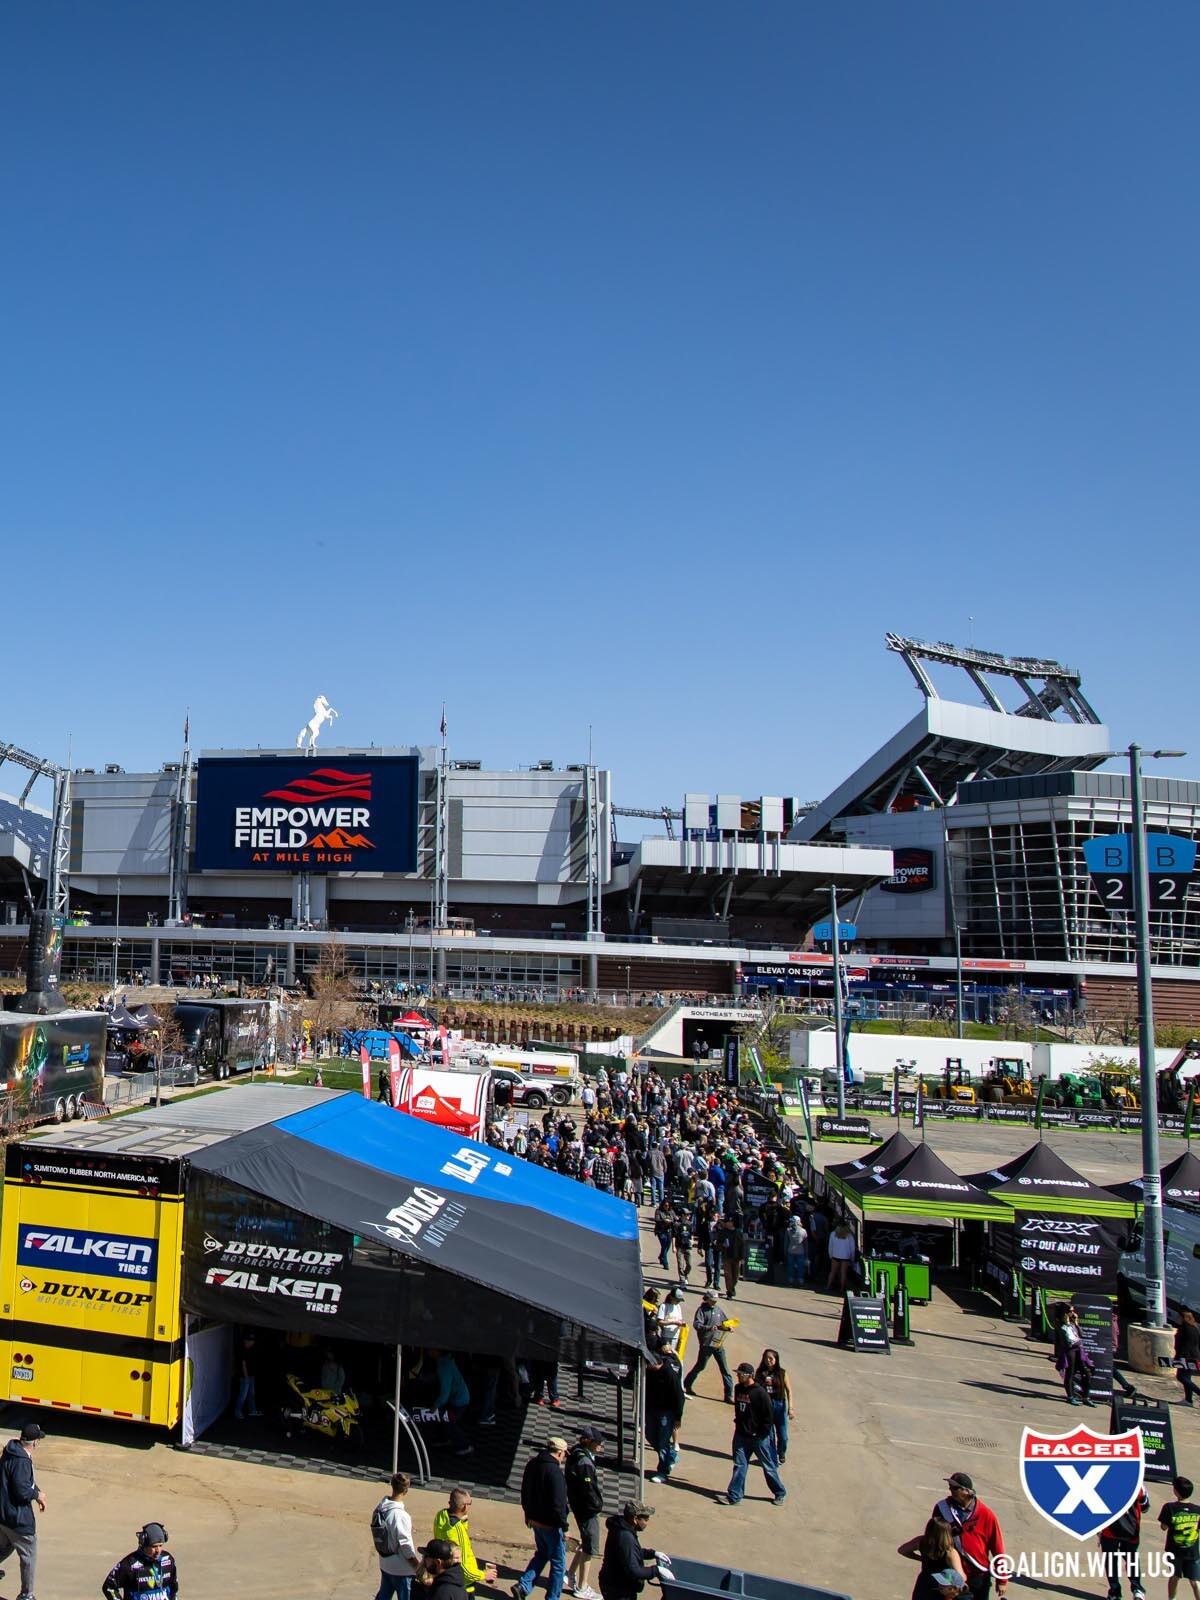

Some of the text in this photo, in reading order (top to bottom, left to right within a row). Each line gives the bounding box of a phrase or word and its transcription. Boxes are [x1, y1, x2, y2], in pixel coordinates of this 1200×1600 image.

[235, 807, 370, 828] EMPOWER
[235, 828, 308, 848] FIELD
[252, 853, 352, 862] AT MILE HIGH
[1105, 847, 1175, 868] B B
[895, 867, 929, 876] POWER
[1106, 879, 1176, 900] 2 2
[822, 928, 849, 938] B B
[823, 941, 848, 951] 1 1
[691, 1010, 733, 1018] SOUTHEAST
[832, 1124, 869, 1132] Kawasaki
[33, 1163, 161, 1184] SUMITOMO RUBBER NORTH AMERICA, INC.
[911, 1180, 970, 1192] Kawasaki
[1033, 1178, 1090, 1189] Kawasaki
[1021, 1218, 1102, 1236] KLX
[24, 1232, 153, 1263] FALKEN
[223, 1240, 344, 1266] DUNLOP
[1038, 1240, 1057, 1251] OUT
[1057, 1242, 1077, 1253] AND
[1077, 1243, 1101, 1255] PLAY
[118, 1262, 148, 1275] TIRES
[220, 1253, 333, 1275] MOTORCYCLE TIRES
[1038, 1261, 1102, 1276] Kawasaki
[205, 1267, 342, 1302] FALKEN
[39, 1281, 153, 1307] DUNLOP
[36, 1295, 142, 1316] MOTORCYCLE TIRES
[305, 1301, 338, 1314] TIRES
